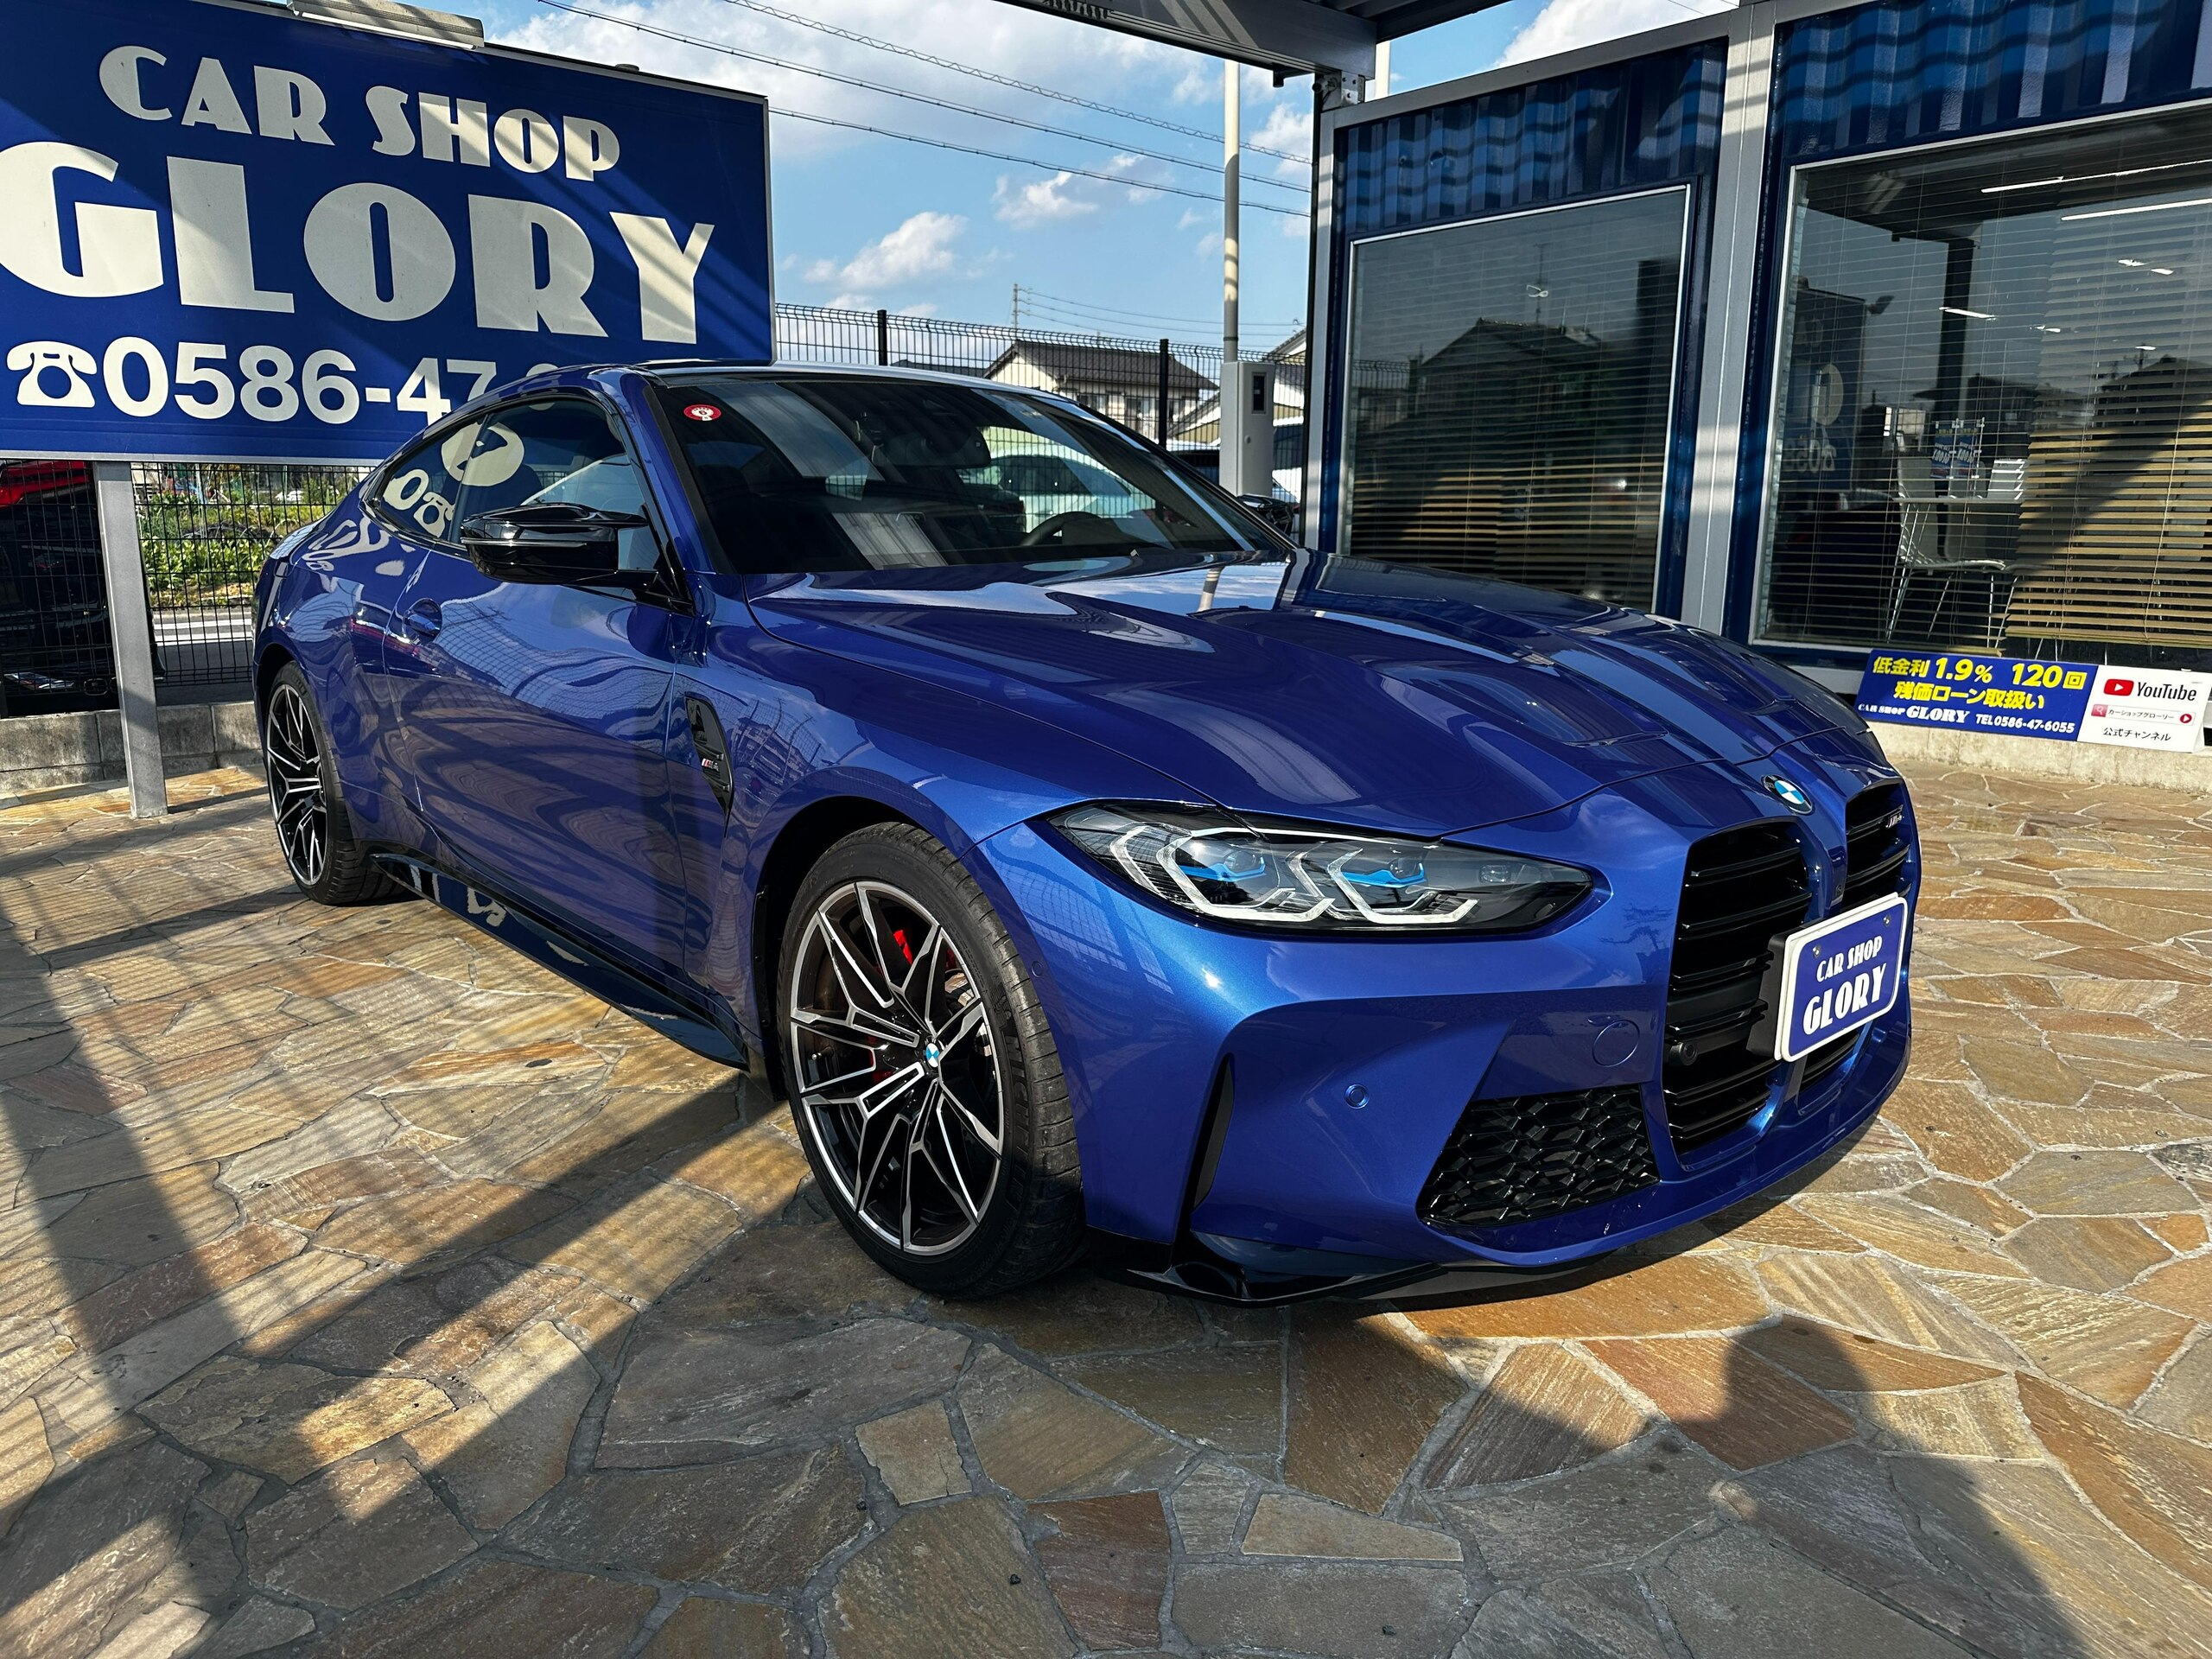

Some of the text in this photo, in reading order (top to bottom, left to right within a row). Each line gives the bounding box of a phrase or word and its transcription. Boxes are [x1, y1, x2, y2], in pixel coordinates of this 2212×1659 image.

[99, 45, 620, 181] CAR SHOP
[0, 142, 715, 344] GLORY
[1872, 656, 2088, 690] 低金利 1.9% 120回
[1893, 681, 2045, 710] 残価ローン取扱い
[2137, 681, 2197, 702] YouTube
[1858, 703, 1878, 713] CAR
[1879, 705, 1906, 715] SHOP
[1906, 705, 1970, 723] GLORY
[2108, 709, 2176, 721] カーショップグローリー
[2103, 727, 2171, 741] 公式チャンネル
[1816, 935, 1883, 982] CAR SHOP
[1802, 963, 1887, 1035] GLORY
